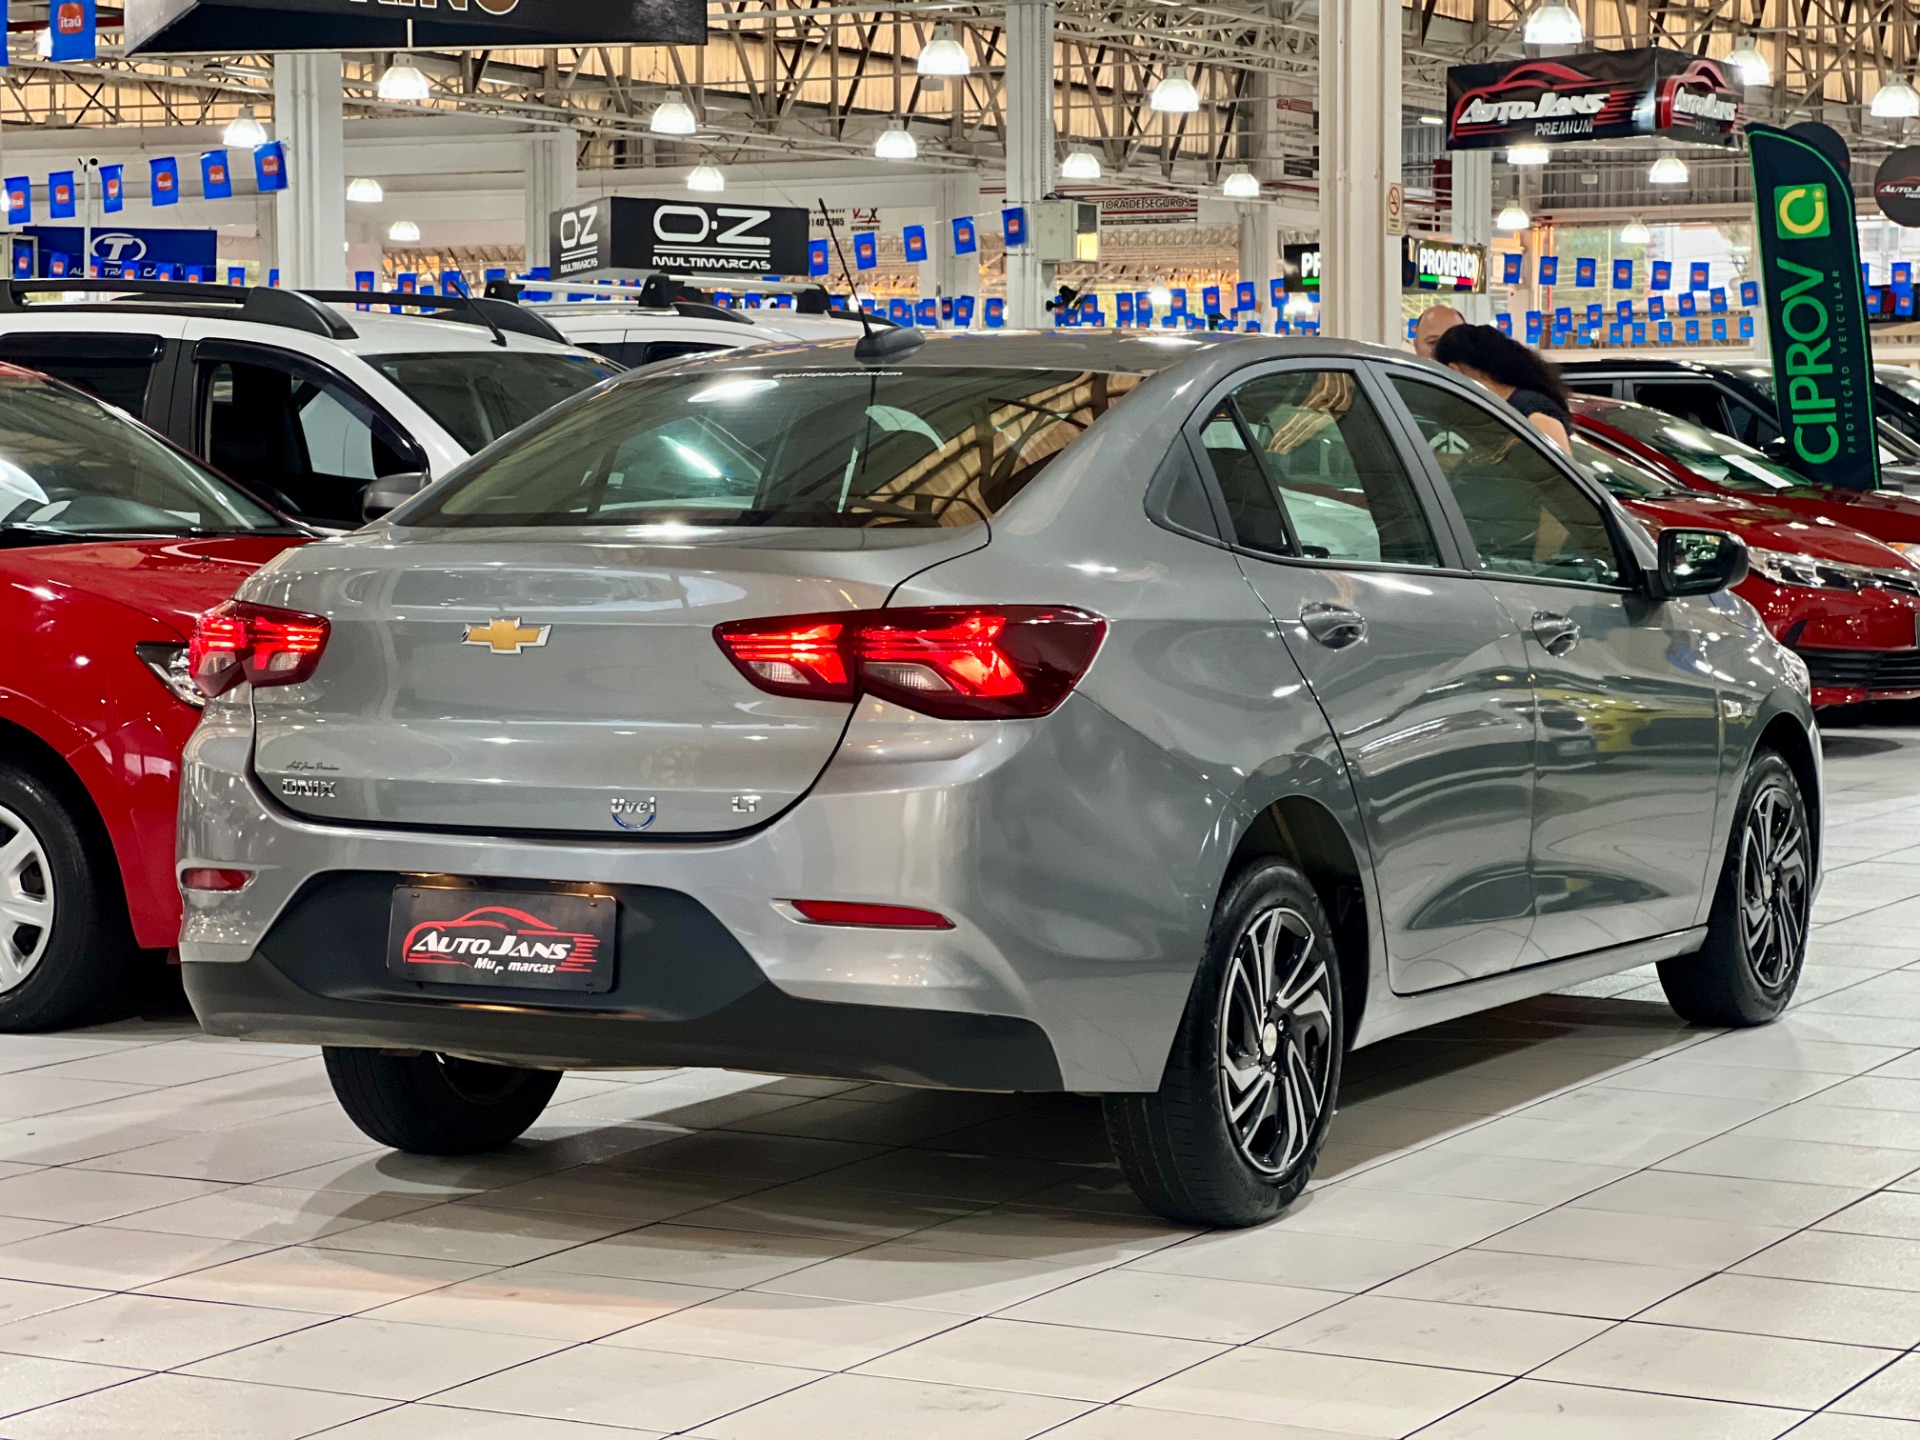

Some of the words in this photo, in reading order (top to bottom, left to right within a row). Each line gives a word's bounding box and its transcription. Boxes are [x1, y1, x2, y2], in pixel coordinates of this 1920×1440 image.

[61, 15, 81, 28] itaú
[1535, 119, 1594, 136] PREMIUM
[561, 257, 598, 273] MULTIMARCAS
[652, 256, 771, 270] MULTIMARCAS
[1832, 270, 1848, 354] VEICULAR
[1776, 257, 1840, 464] CIPROV
[1841, 366, 1857, 454] PROTEÇÃO
[282, 778, 336, 797] ONIX
